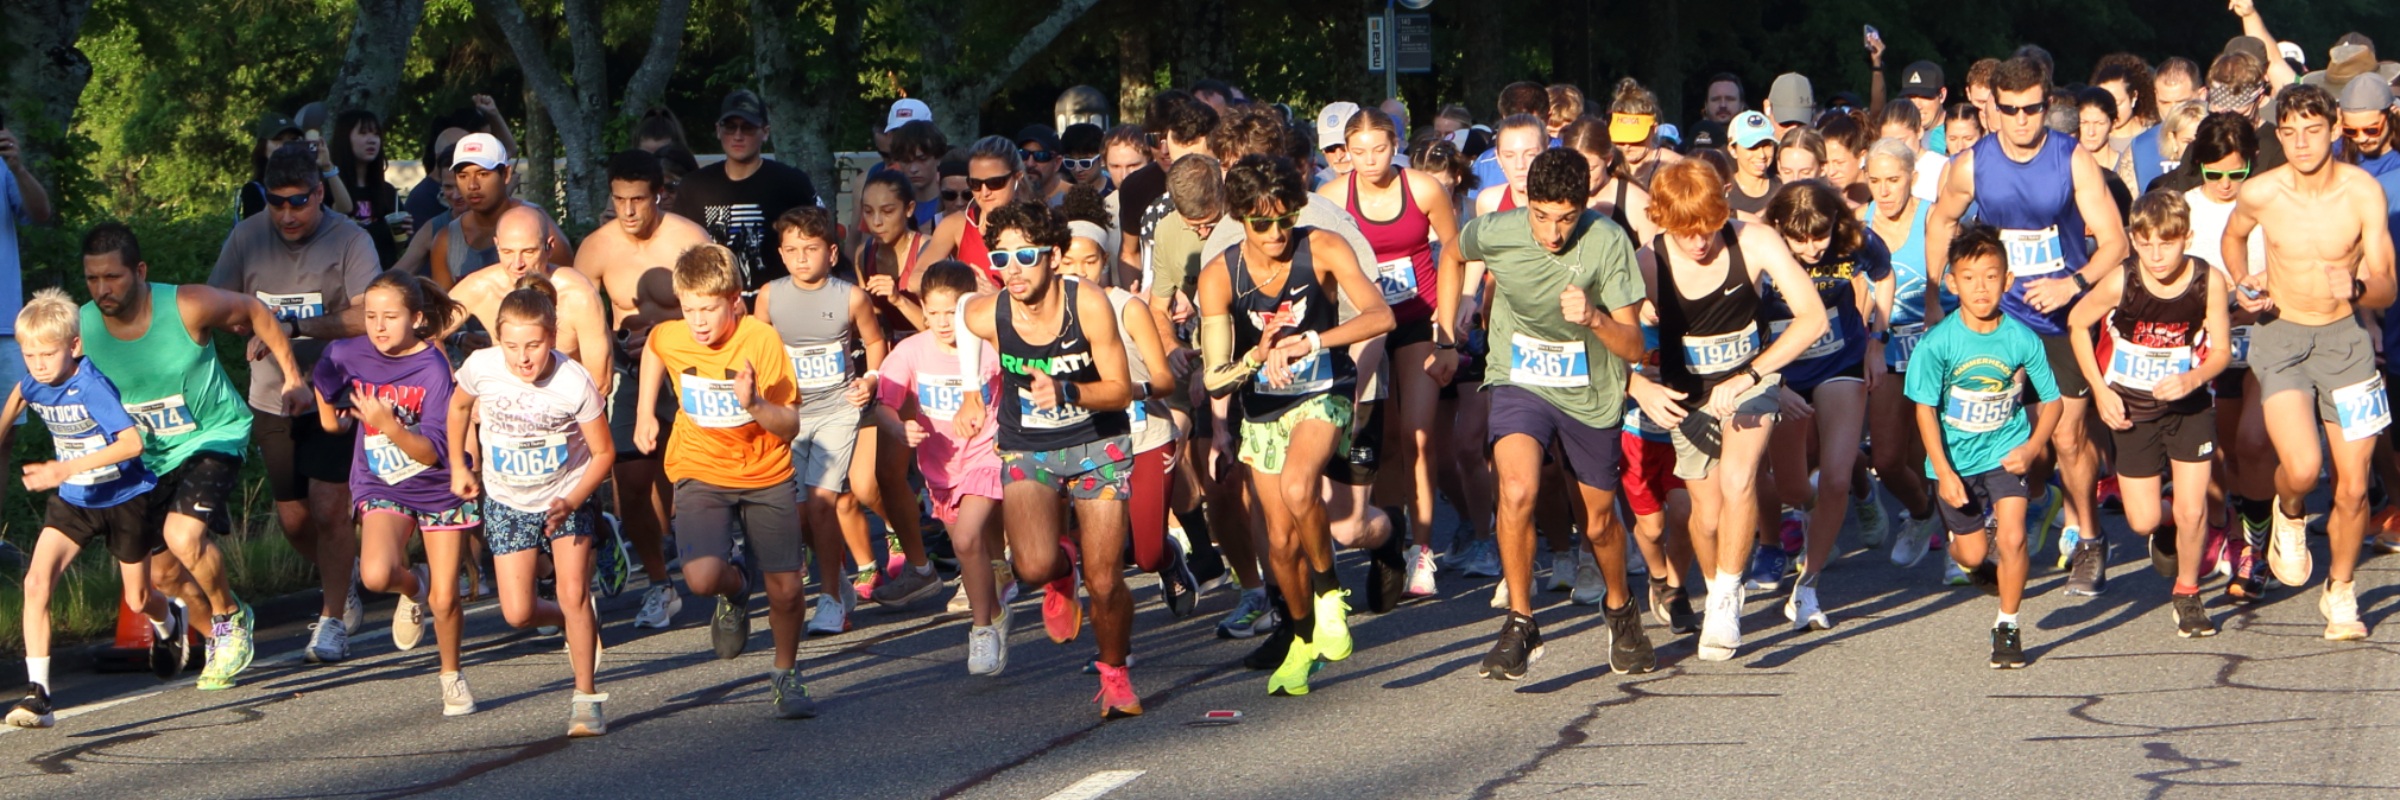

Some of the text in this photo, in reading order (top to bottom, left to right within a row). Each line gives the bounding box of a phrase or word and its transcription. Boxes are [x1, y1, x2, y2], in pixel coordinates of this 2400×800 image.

[1372, 31, 1380, 68] marta
[1381, 270, 1409, 295] 26
[1519, 346, 1576, 377] 2367
[1694, 337, 1751, 365] 1946
[2123, 353, 2181, 382] 1955
[926, 386, 964, 412] 193
[1959, 398, 2014, 423] 1959
[372, 444, 416, 474] 20
[498, 446, 560, 475] 2064
